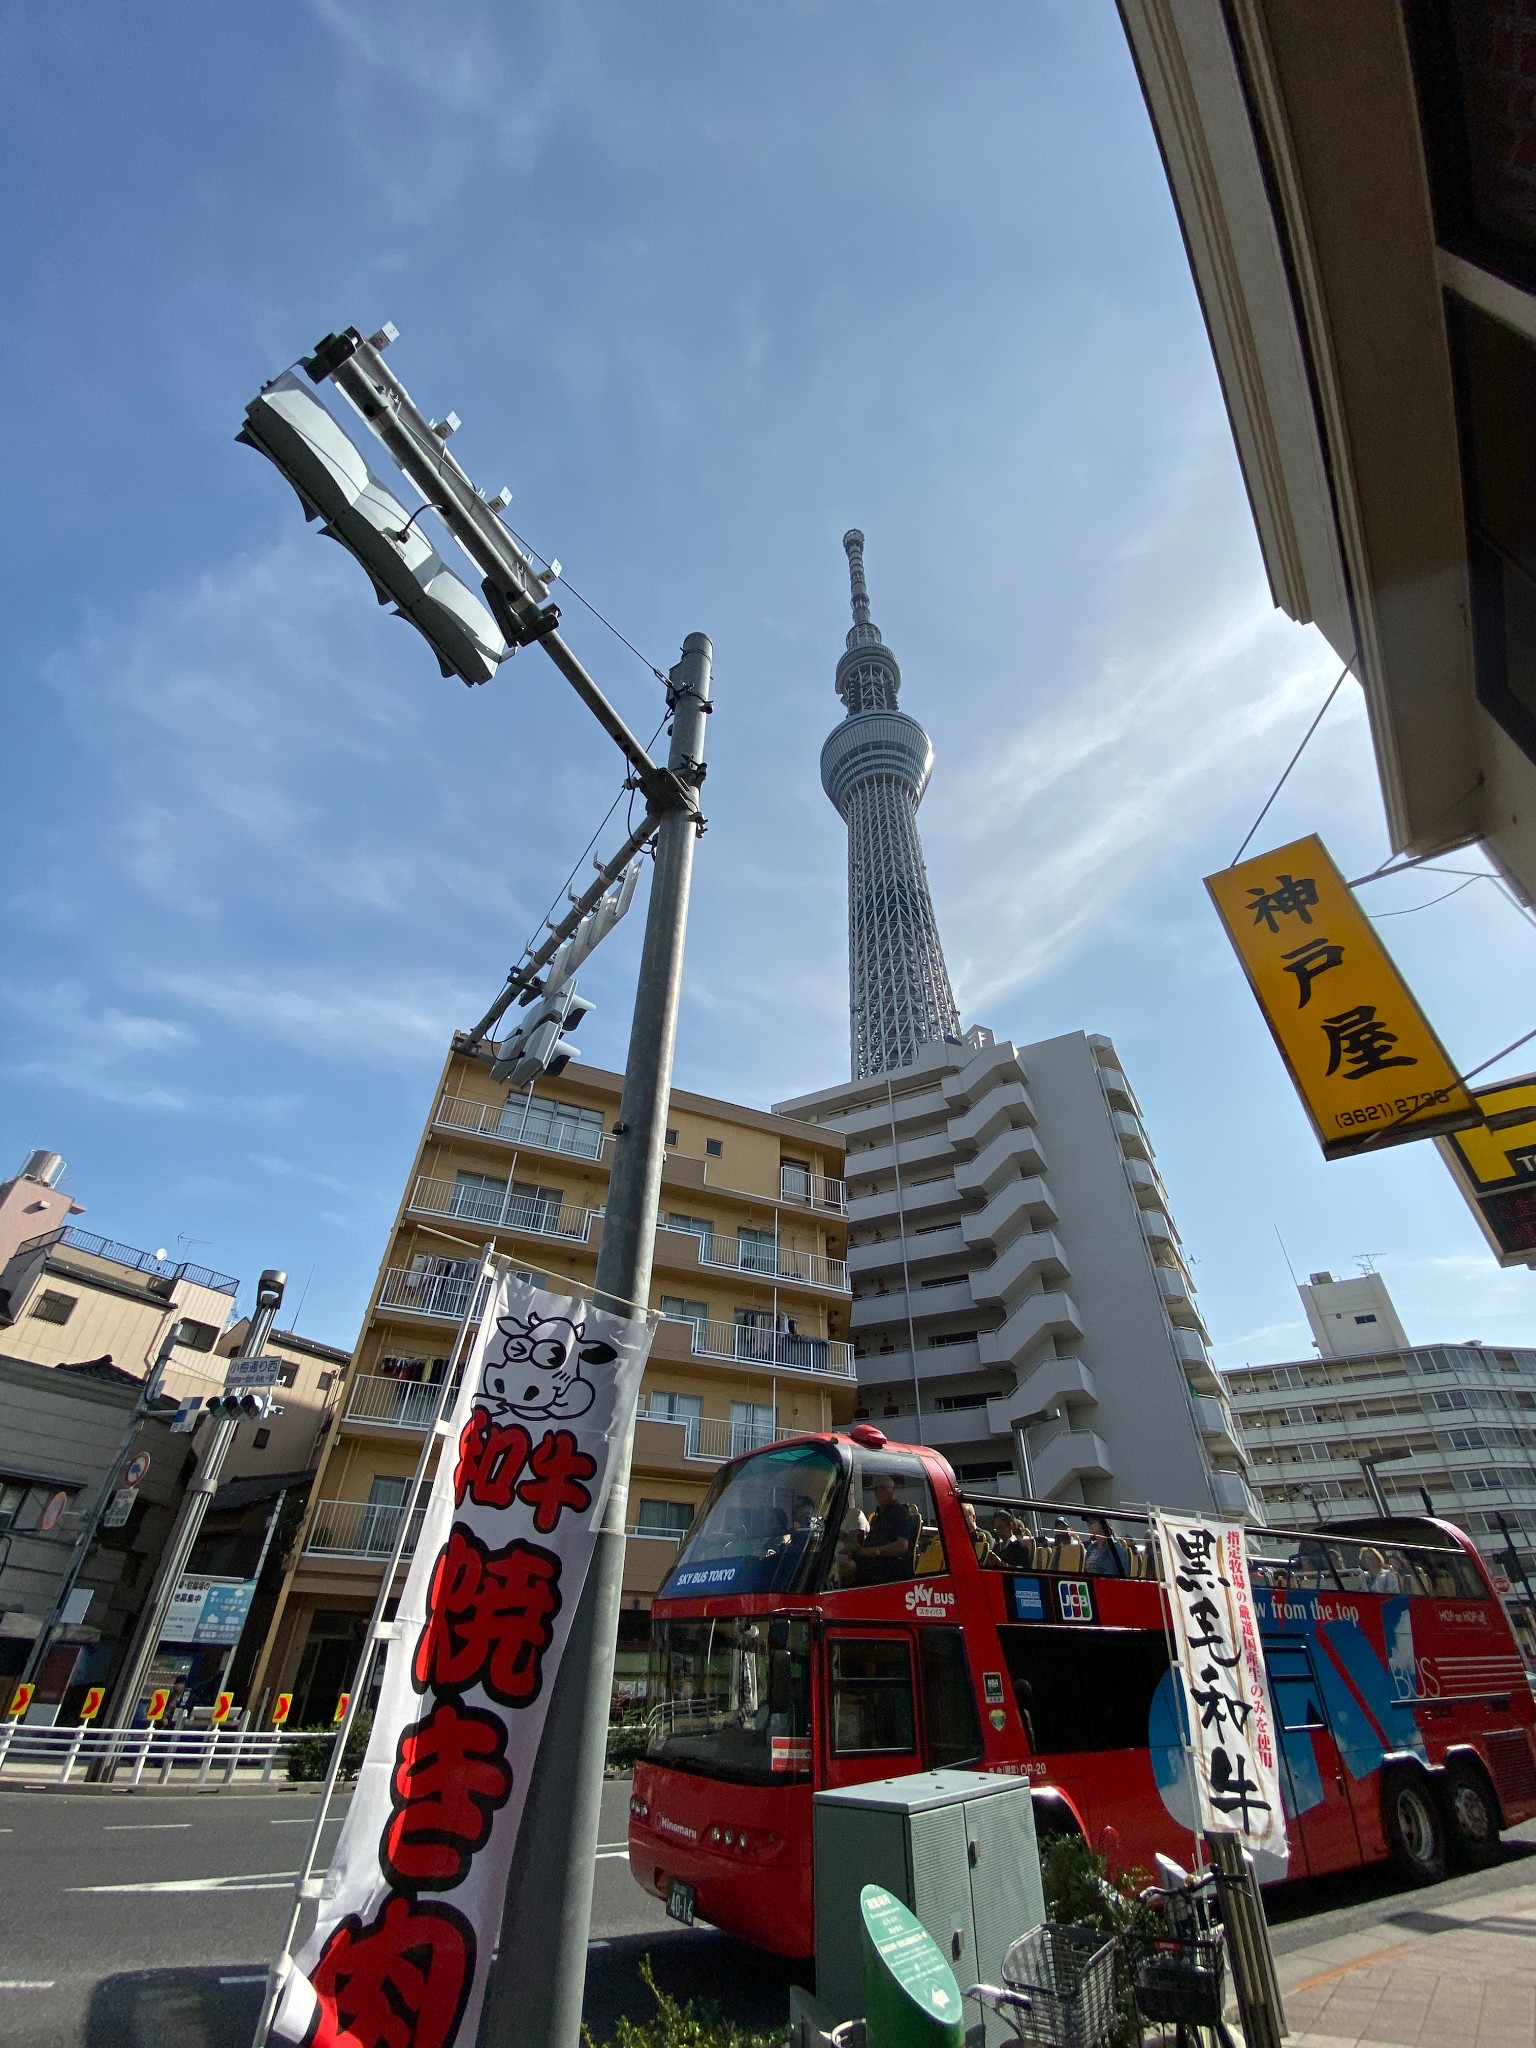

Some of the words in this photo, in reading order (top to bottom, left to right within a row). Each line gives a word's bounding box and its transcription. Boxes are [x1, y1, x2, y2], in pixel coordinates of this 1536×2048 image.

[1245, 875, 1418, 1080] 神戸屋
[230, 1360, 279, 1374] 小梅通り西
[455, 1404, 597, 1533] 和牛
[677, 1573, 694, 1586] SKY
[692, 1571, 709, 1584] BUS
[708, 1568, 736, 1582] TOKYO
[905, 1584, 933, 1610] SKY
[934, 1593, 955, 1605] BUS
[1016, 1590, 1039, 1598] AMERICAN
[1062, 1595, 1089, 1607] JCB
[1271, 1595, 1307, 1620] from
[1310, 1598, 1333, 1620] the
[1336, 1602, 1359, 1628] top
[1226, 1530, 1273, 1769] 指定牧場の厳選国産牛のみを使用
[1176, 1528, 1272, 1836] 黒毛和牛
[1390, 1656, 1441, 1699] BUS
[308, 1521, 564, 2048] 焼き肉
[1020, 1763, 1047, 1776] OP-20
[661, 1816, 697, 1840] Hinomaru
[669, 1892, 694, 1923] 40-16
